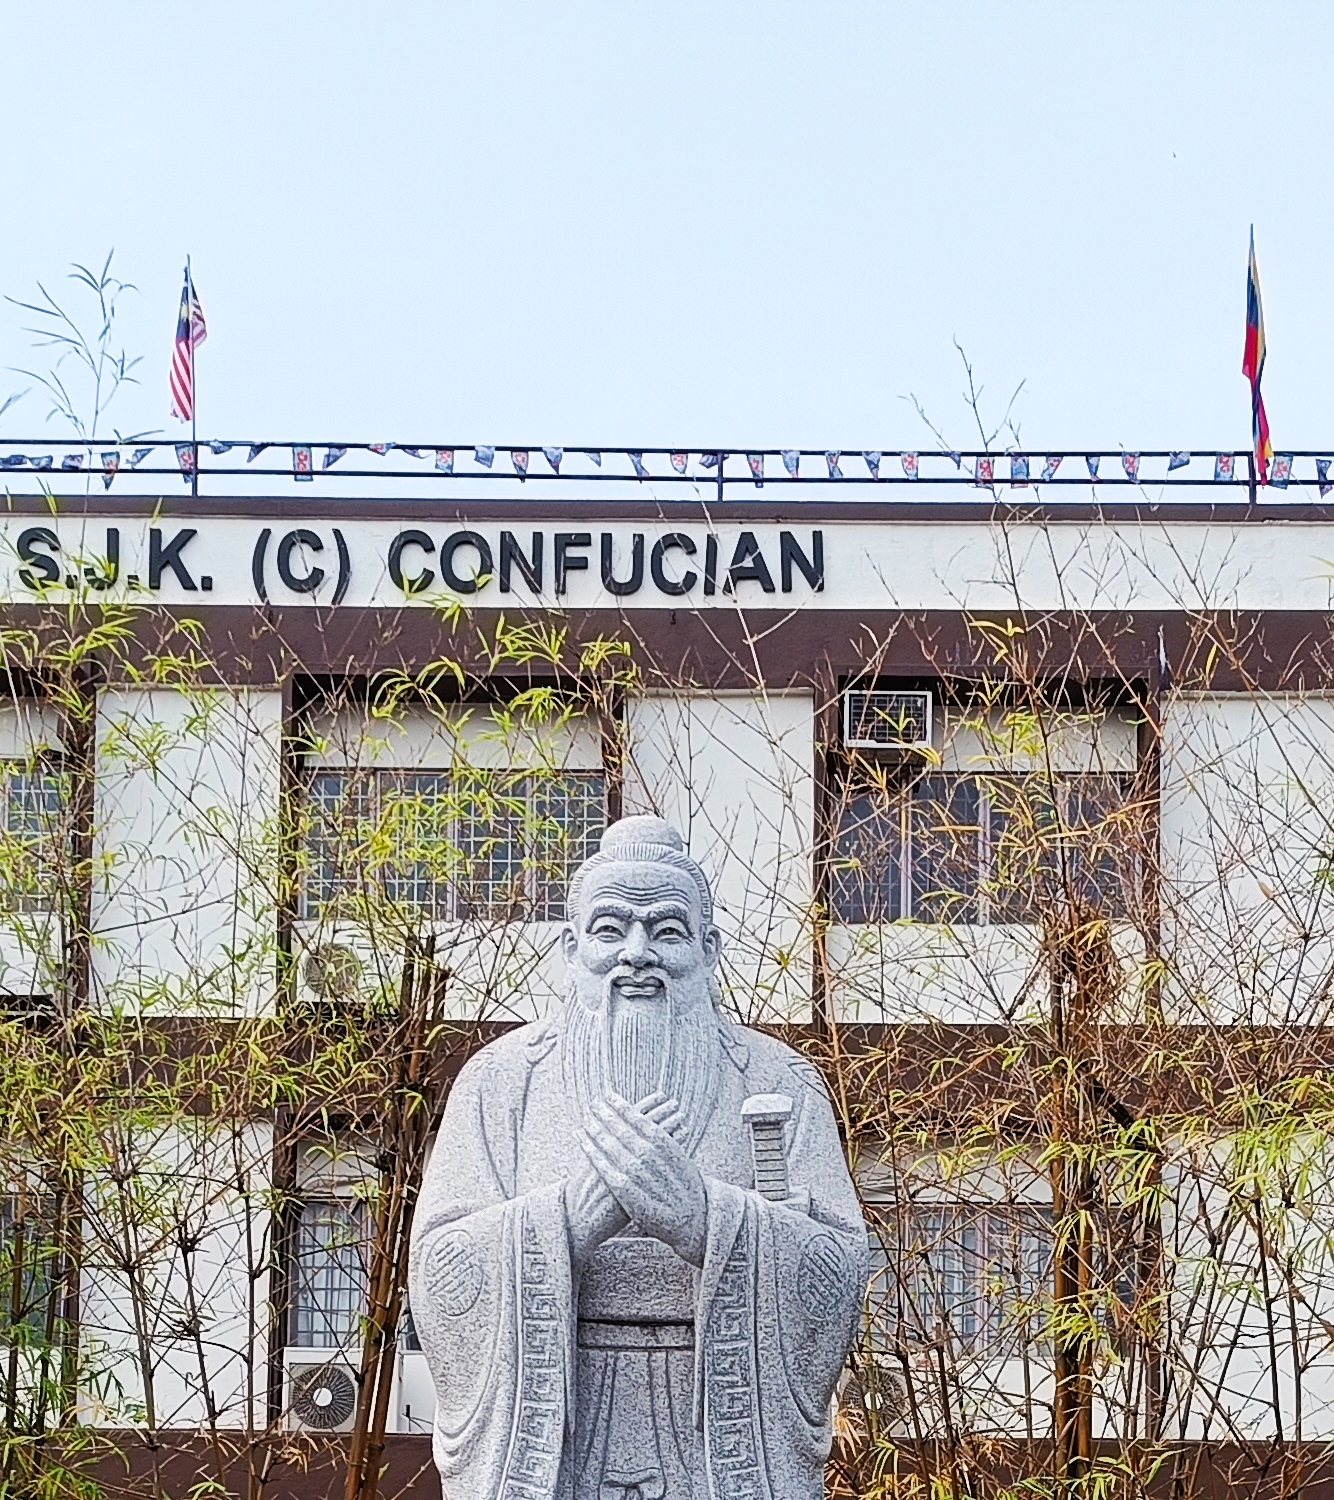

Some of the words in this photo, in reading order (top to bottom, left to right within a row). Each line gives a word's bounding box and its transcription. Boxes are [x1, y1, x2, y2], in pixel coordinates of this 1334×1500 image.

[16, 526, 213, 592] S.J.K.
[253, 527, 351, 605] (C)
[389, 528, 826, 597] CONFUCIAN
